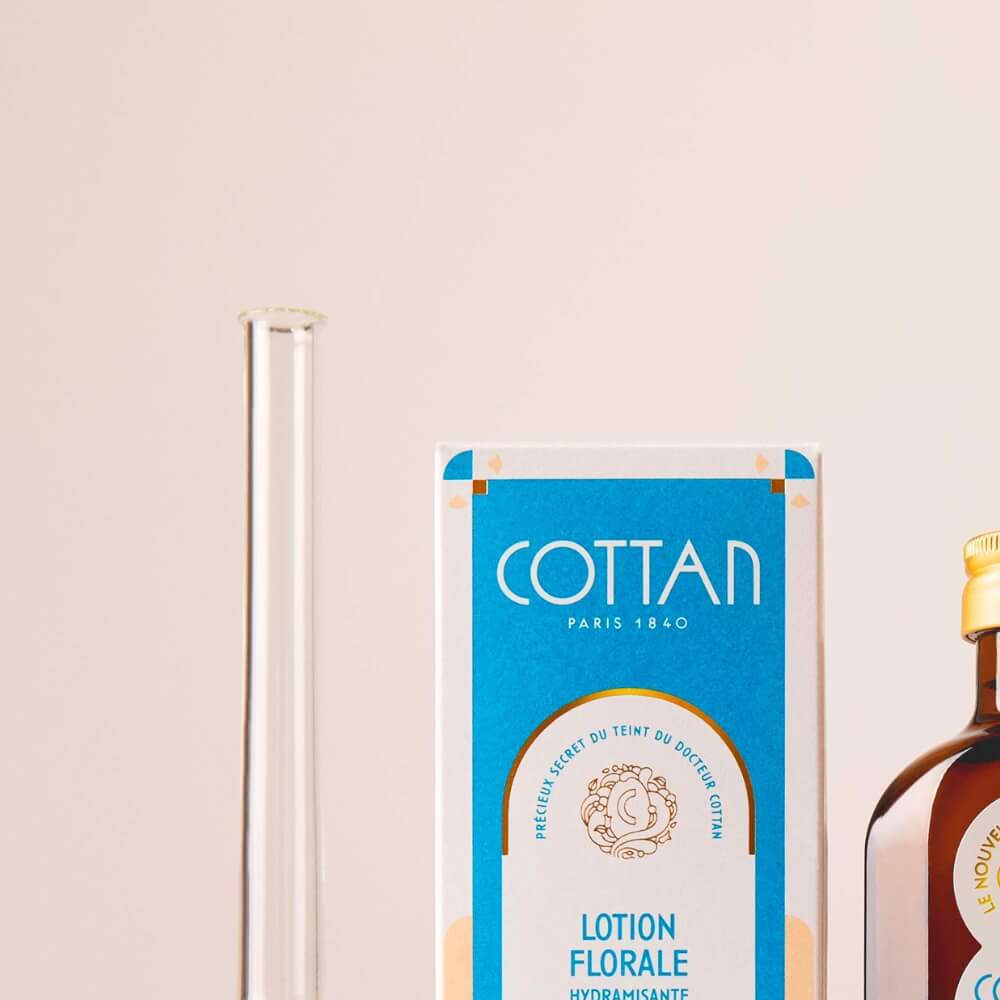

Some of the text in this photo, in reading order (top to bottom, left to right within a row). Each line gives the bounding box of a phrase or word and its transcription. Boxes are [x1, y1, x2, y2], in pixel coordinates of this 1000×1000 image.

[497, 538, 761, 606] COTTAN
[568, 617, 689, 630] PARIS 1840
[535, 725, 723, 840] PRÉCIEUX SECRET DU TEINT DU DOCTEUR COTTAN
[977, 894, 997, 914] LE
[581, 913, 676, 941] LOTION
[569, 949, 689, 978] FLORALE
